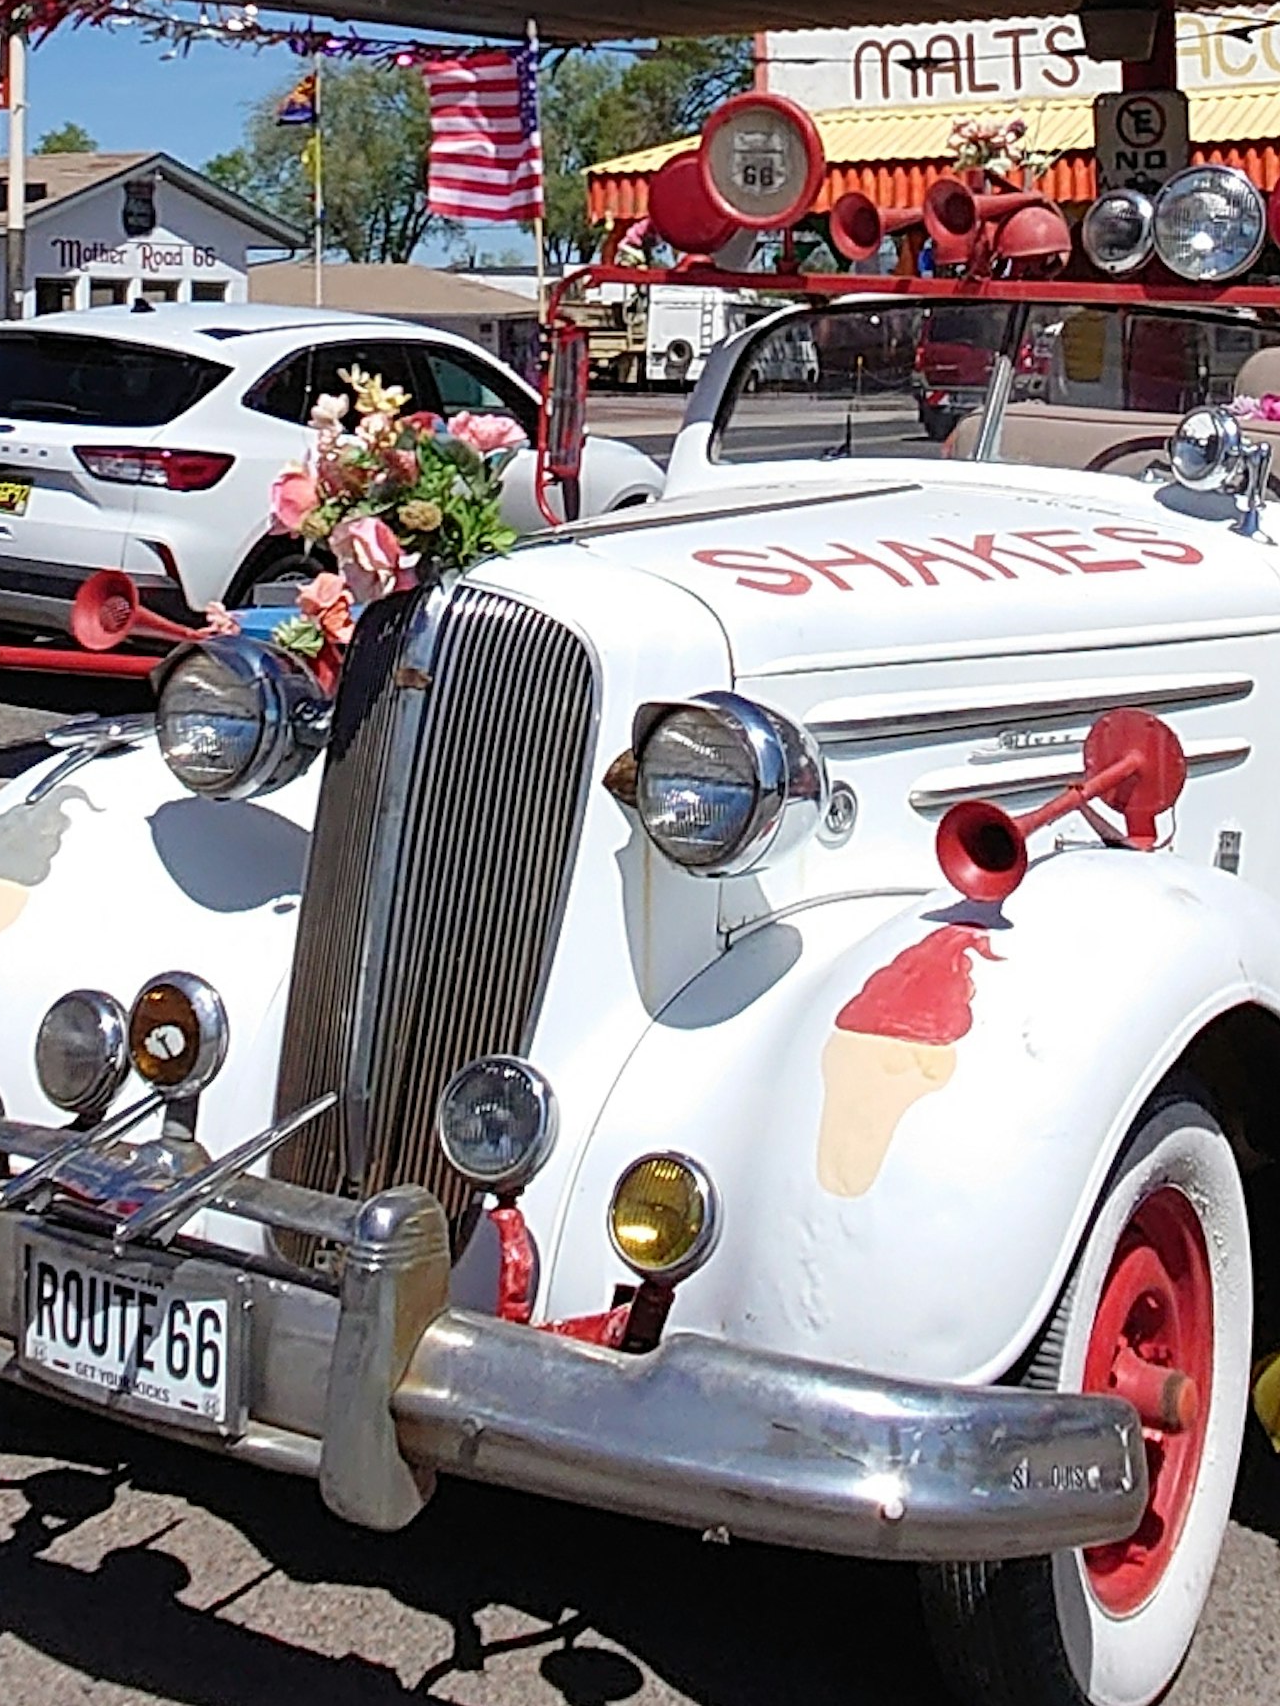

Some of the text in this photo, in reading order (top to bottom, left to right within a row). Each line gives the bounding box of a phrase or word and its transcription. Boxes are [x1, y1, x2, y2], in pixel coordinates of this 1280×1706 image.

[853, 23, 1082, 101] MALTS
[1115, 150, 1167, 170] NO
[51, 238, 217, 273] Mother Road 66
[692, 524, 1205, 596] SHAKES
[36, 1260, 221, 1389] ROUTE 66
[75, 1361, 96, 1381] GET
[134, 1382, 170, 1403] KICKS
